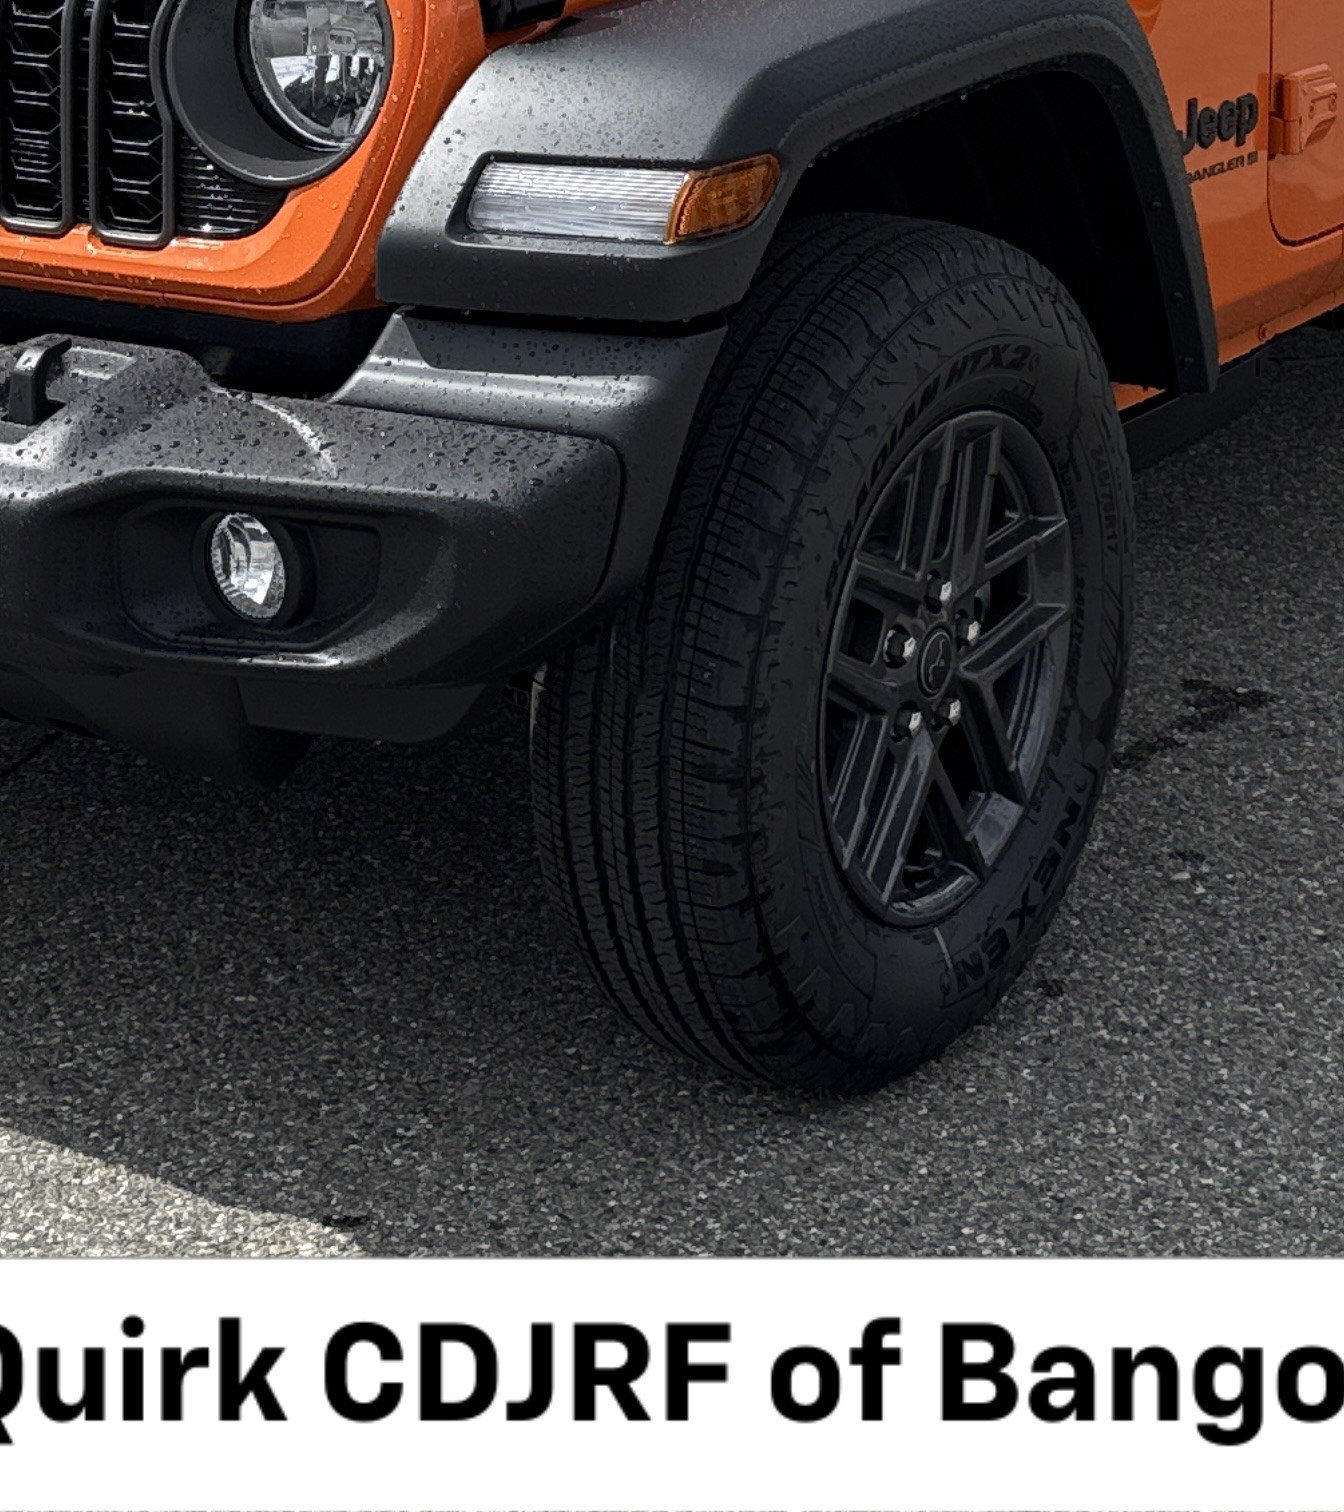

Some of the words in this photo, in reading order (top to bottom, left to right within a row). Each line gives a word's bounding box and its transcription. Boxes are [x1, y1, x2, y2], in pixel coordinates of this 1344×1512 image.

[1178, 92, 1259, 155] Jeep
[945, 343, 1031, 392] HTX2
[957, 795, 1082, 993] NEXEN
